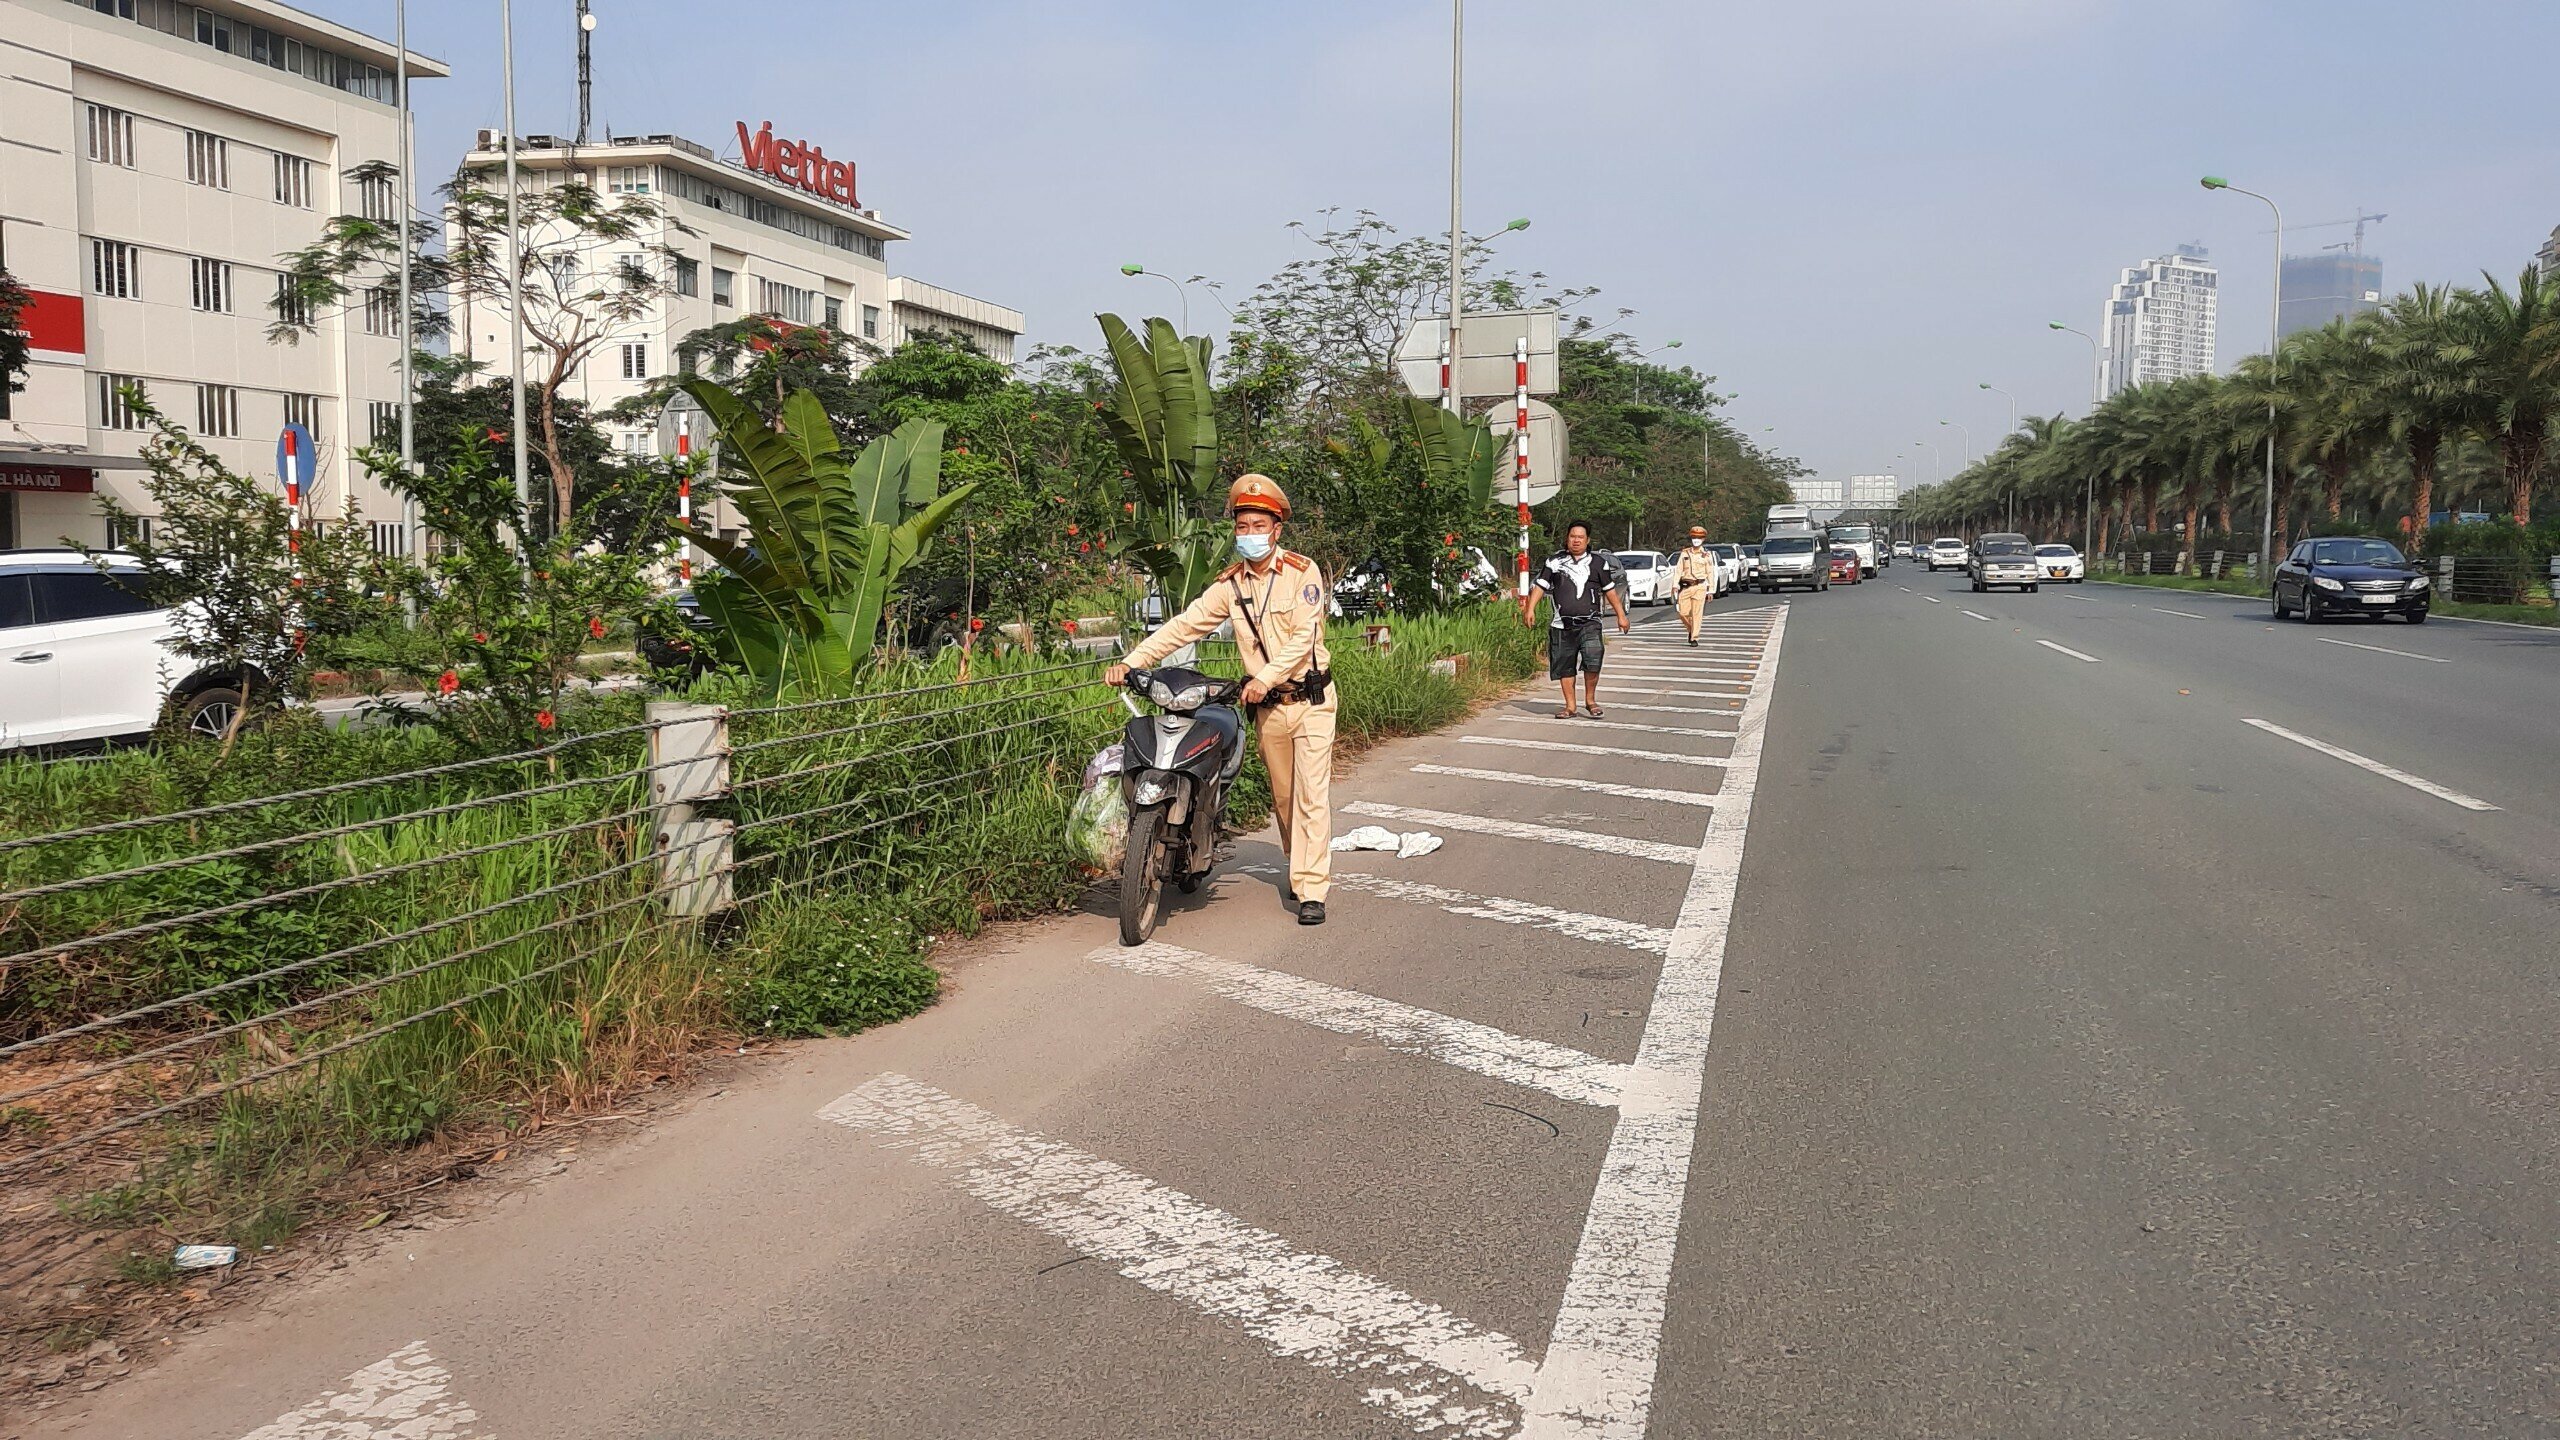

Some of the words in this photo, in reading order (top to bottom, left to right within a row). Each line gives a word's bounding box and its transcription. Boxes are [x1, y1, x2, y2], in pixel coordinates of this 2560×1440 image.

[736, 120, 862, 209] Viettel
[13, 469, 34, 486] HÀ
[35, 470, 61, 490] NỘI
